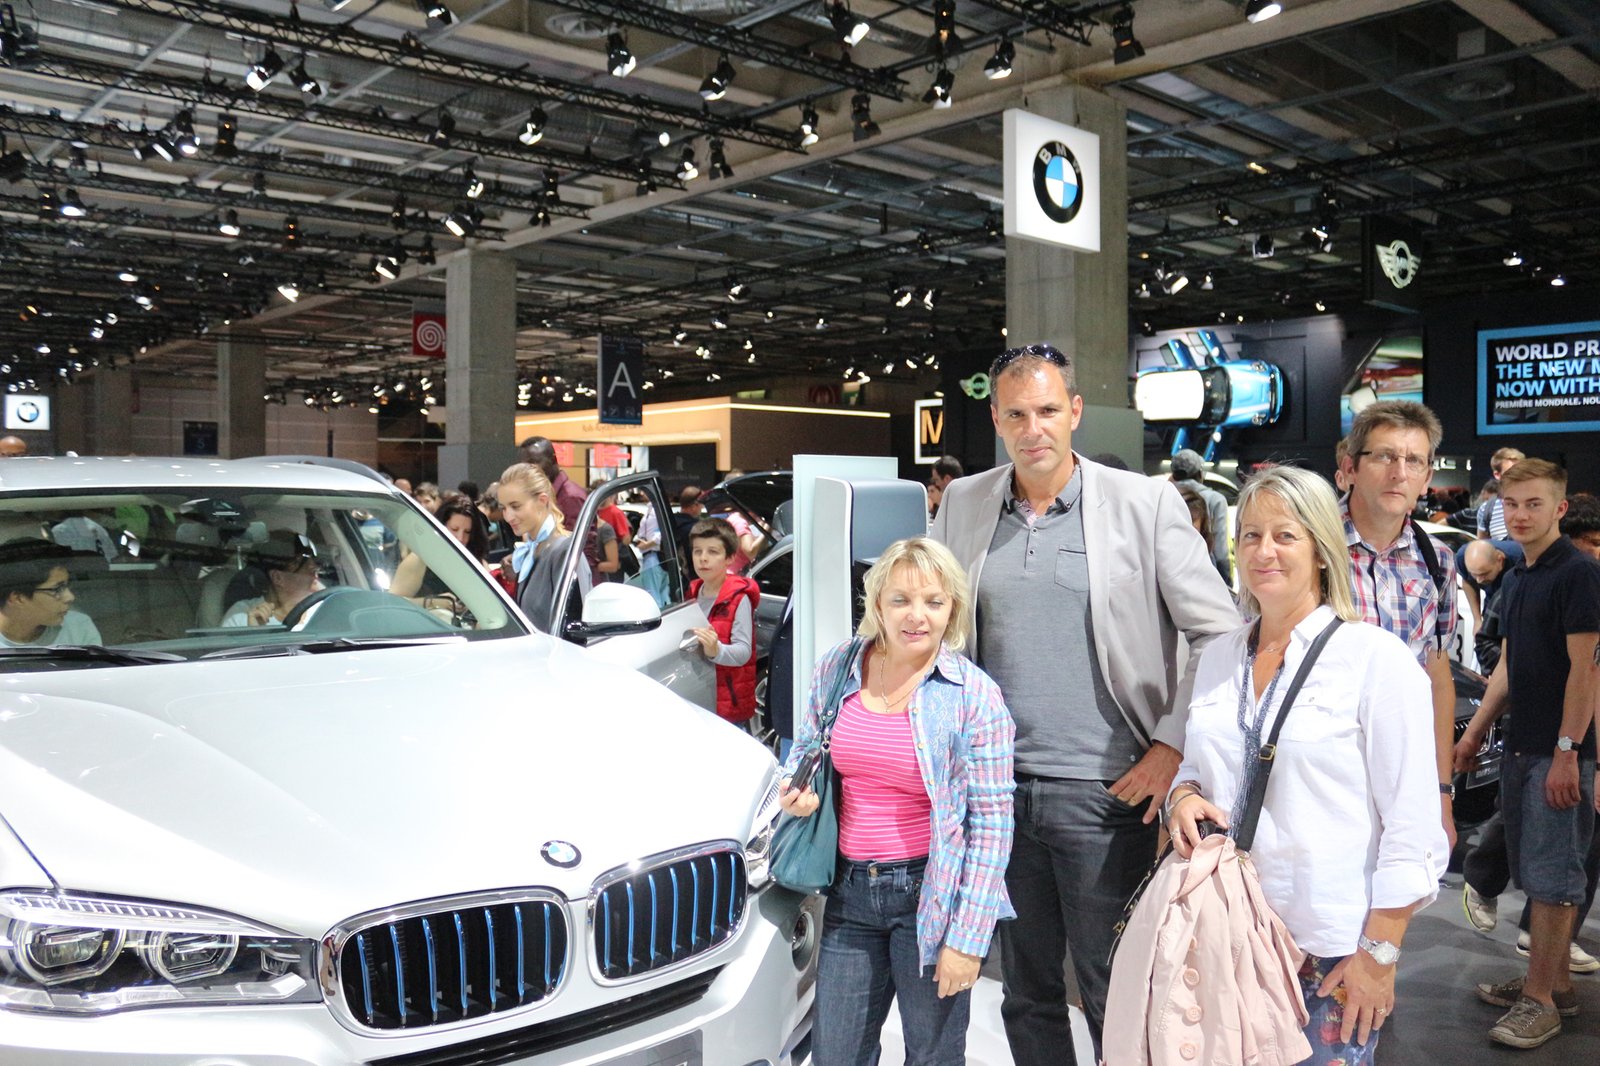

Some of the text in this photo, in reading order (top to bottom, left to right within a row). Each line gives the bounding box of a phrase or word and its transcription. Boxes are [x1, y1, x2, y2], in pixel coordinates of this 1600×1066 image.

[1039, 143, 1081, 174] BMW
[1495, 342, 1568, 362] WORLD
[607, 361, 637, 399] A
[1496, 362, 1533, 380] THE
[1539, 358, 1586, 378] NEW
[1496, 380, 1546, 398] NOW
